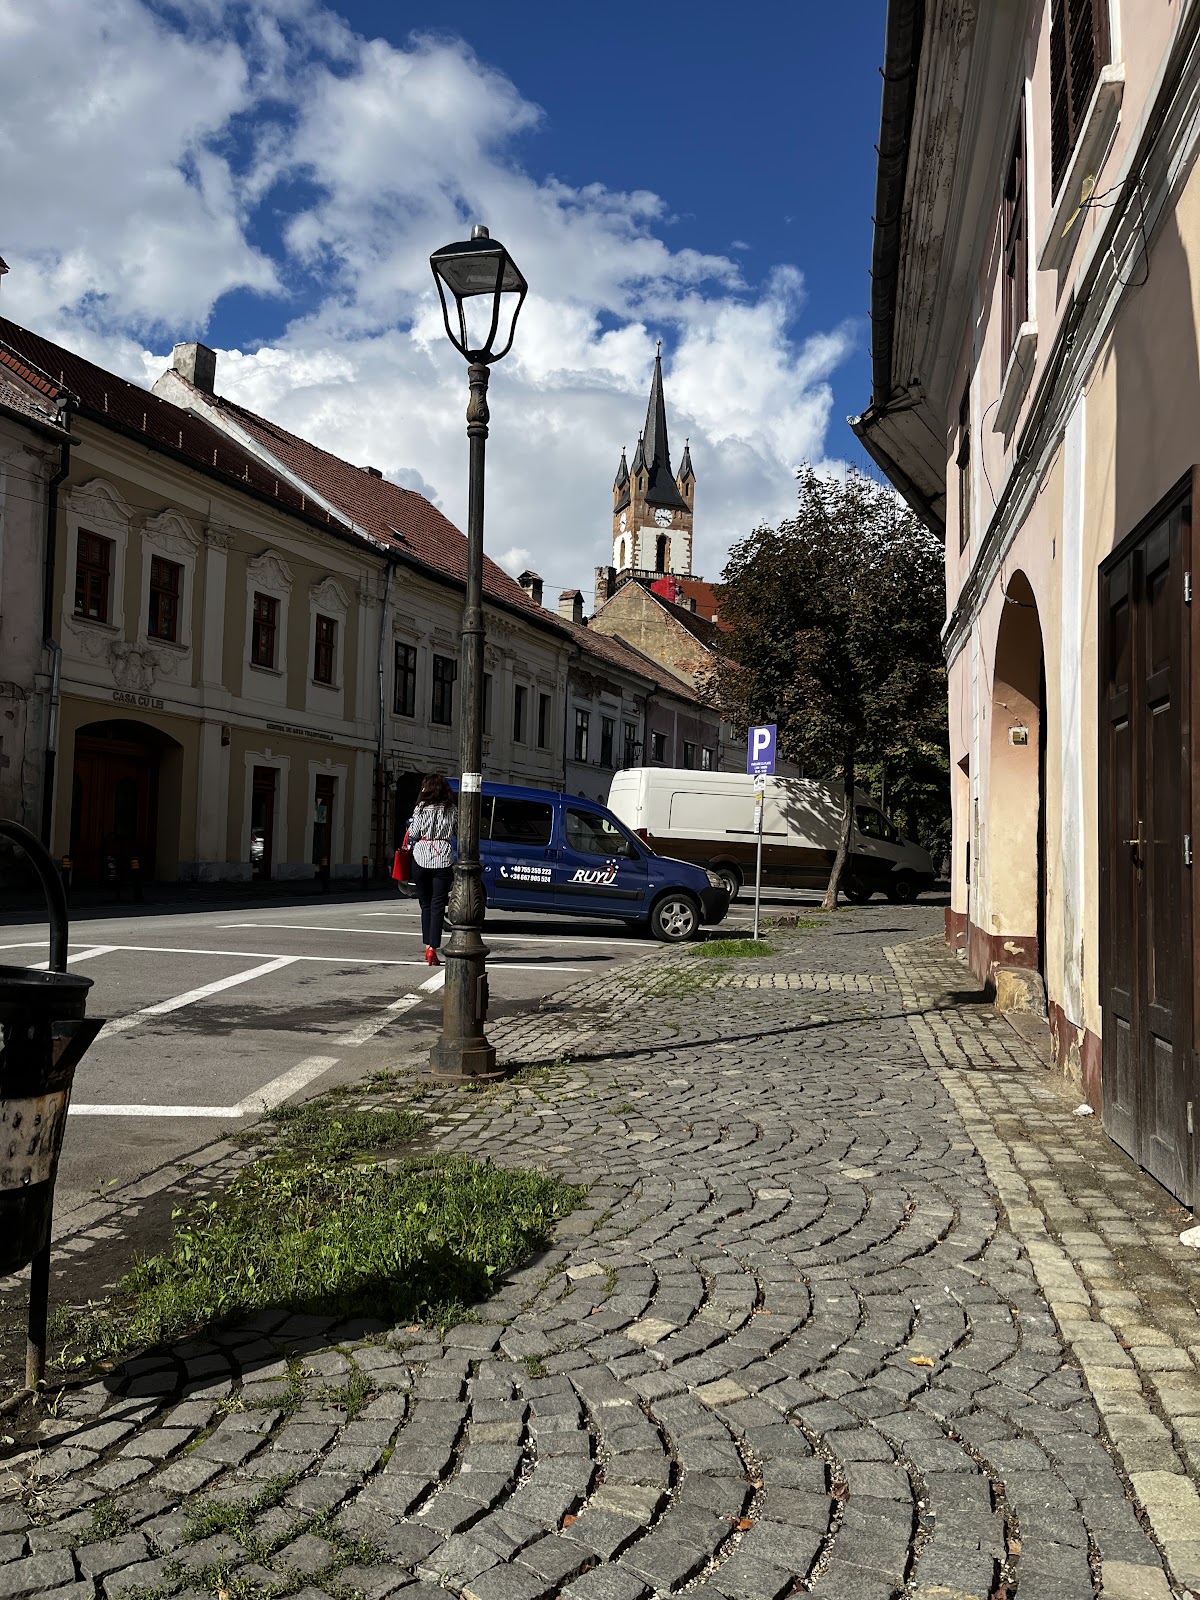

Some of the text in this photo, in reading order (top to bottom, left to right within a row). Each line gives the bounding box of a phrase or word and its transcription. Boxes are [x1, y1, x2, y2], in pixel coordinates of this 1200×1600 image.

[113, 691, 163, 709] CASA CU LEI
[753, 728, 770, 760] P
